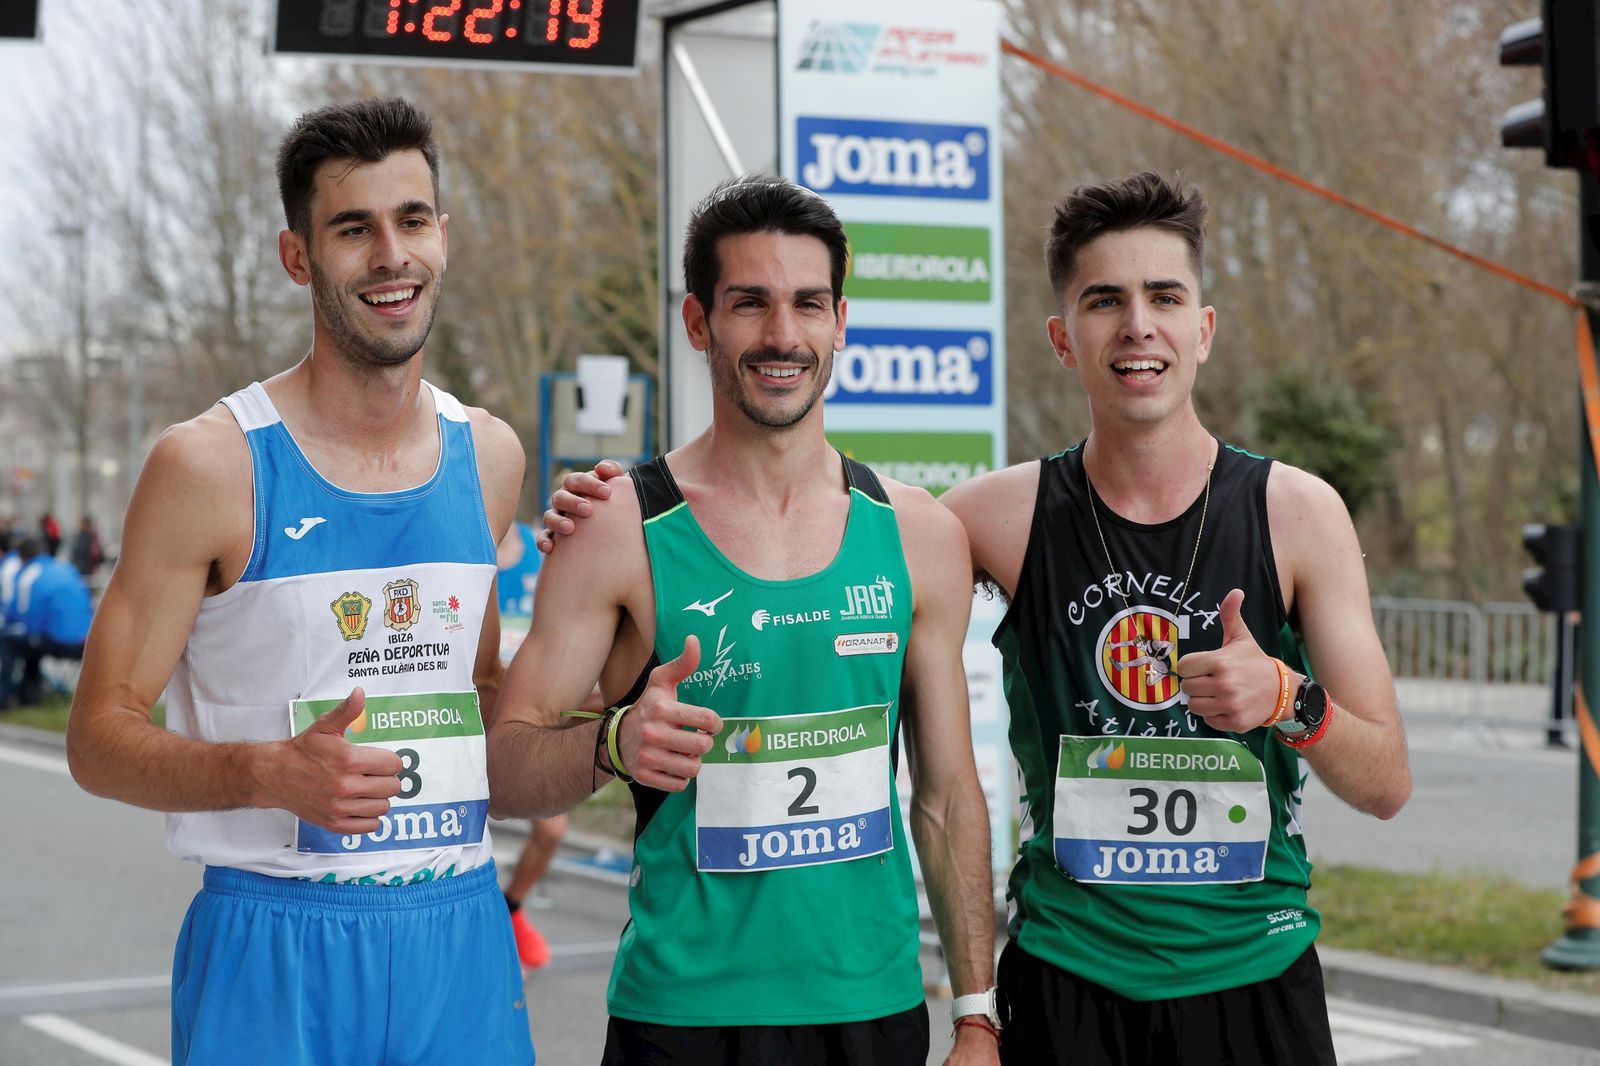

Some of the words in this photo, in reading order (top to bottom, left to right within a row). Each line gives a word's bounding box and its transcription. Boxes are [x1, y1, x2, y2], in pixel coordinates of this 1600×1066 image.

[854, 253, 989, 282] IBERDROLA
[393, 587, 409, 598] PXD
[840, 585, 888, 615] JAG
[773, 610, 831, 627] FISALDE
[388, 633, 413, 645] IBIZA
[348, 647, 380, 664] PEÑA
[384, 643, 450, 662] DEPORTIVA
[348, 666, 379, 678] SANTA
[417, 661, 435, 672] DES
[437, 660, 448, 671] RIU
[371, 708, 463, 730] IBERDROLA
[767, 722, 867, 751] IBERDROLA
[1130, 752, 1241, 771] IBERDROLA
[389, 748, 423, 800] 8
[787, 766, 820, 817] 2
[1127, 787, 1198, 836] 30
